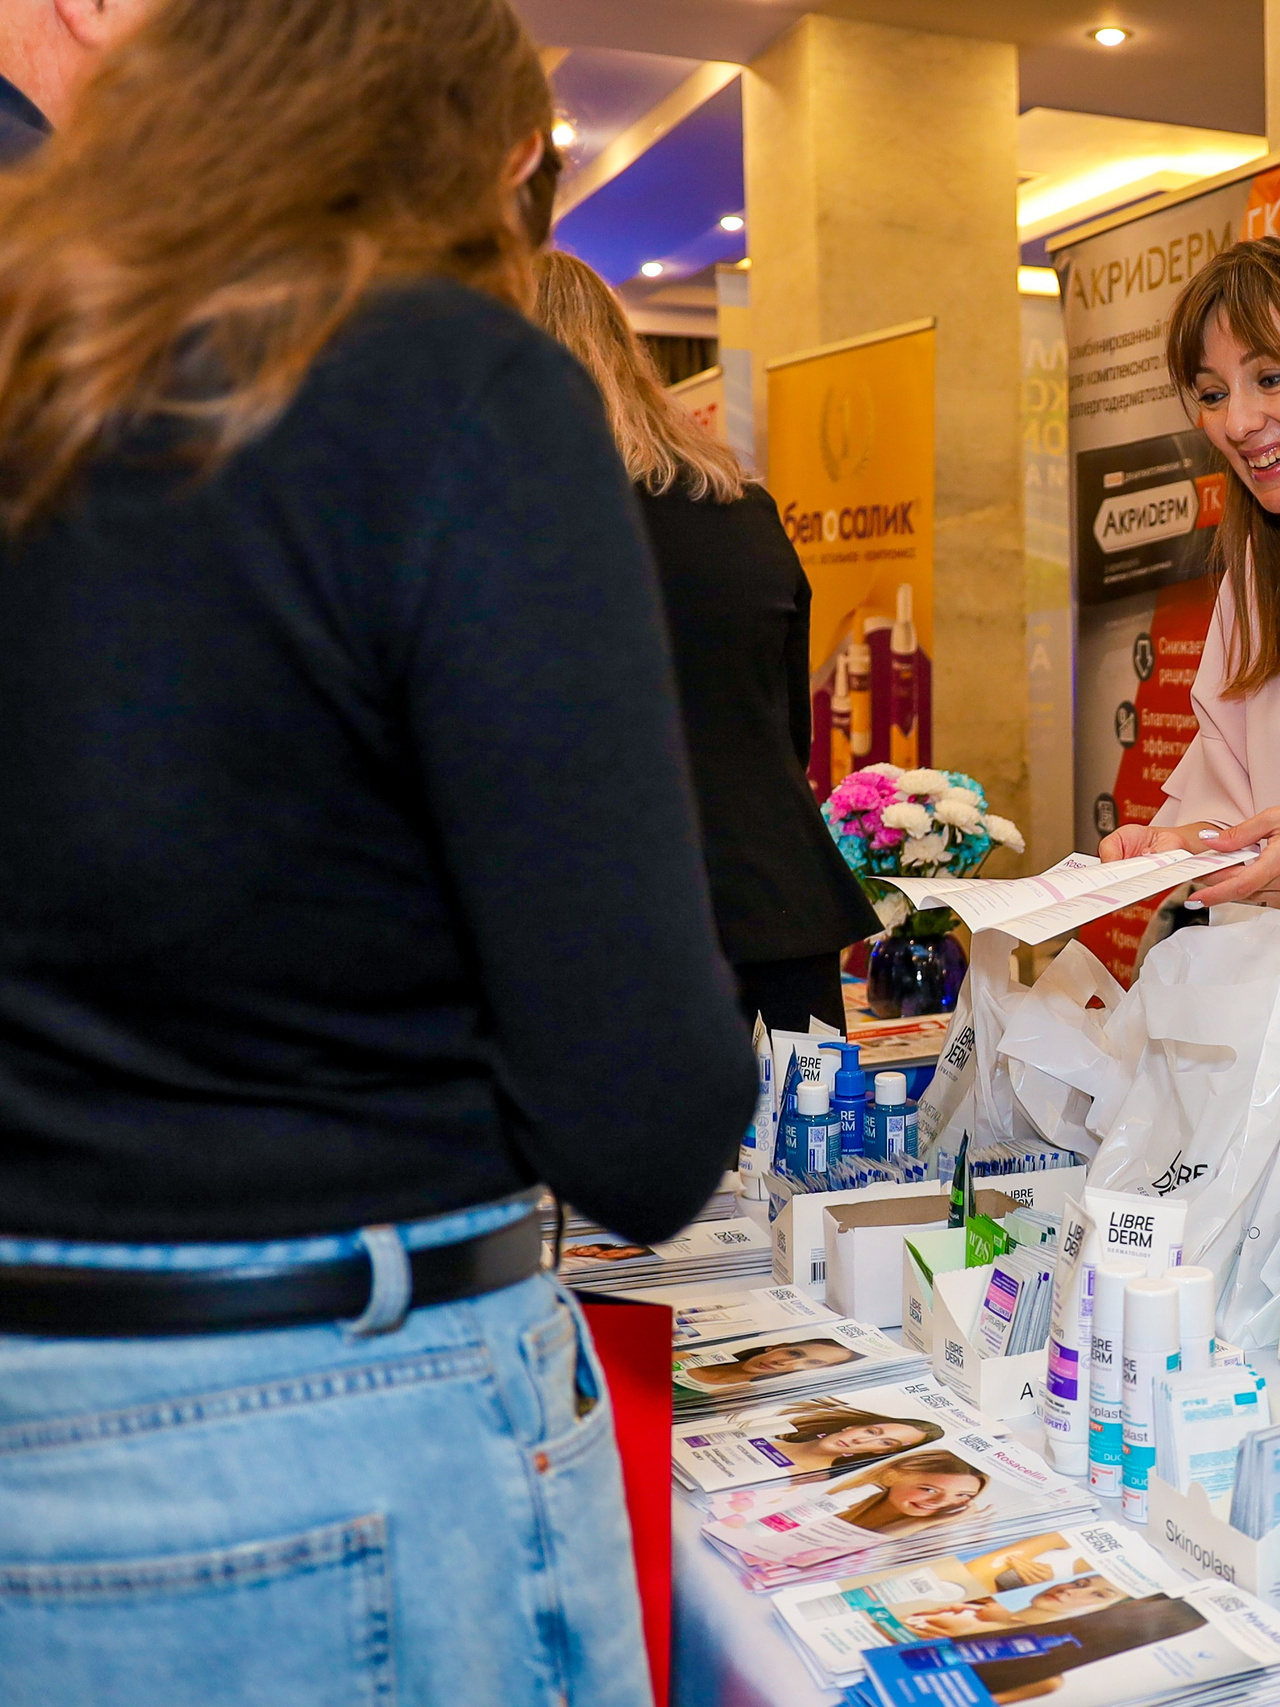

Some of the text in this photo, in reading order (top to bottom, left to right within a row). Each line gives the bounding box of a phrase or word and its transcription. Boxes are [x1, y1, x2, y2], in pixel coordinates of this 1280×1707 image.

[1110, 1212, 1155, 1232] LIBRE
[1108, 1228, 1152, 1248] DERM
[945, 1338, 964, 1357] LIBRE
[1092, 1336, 1112, 1351] BRE
[945, 1350, 964, 1370] DERM
[1091, 1350, 1112, 1364] ERM
[959, 1437, 986, 1452] DERM
[967, 1433, 994, 1449] LIBRE
[994, 1451, 1048, 1482] Rosacellin
[1081, 1531, 1112, 1554] DERM
[1093, 1527, 1123, 1551] LIBRE
[1165, 1519, 1236, 1583] Skinoplast
